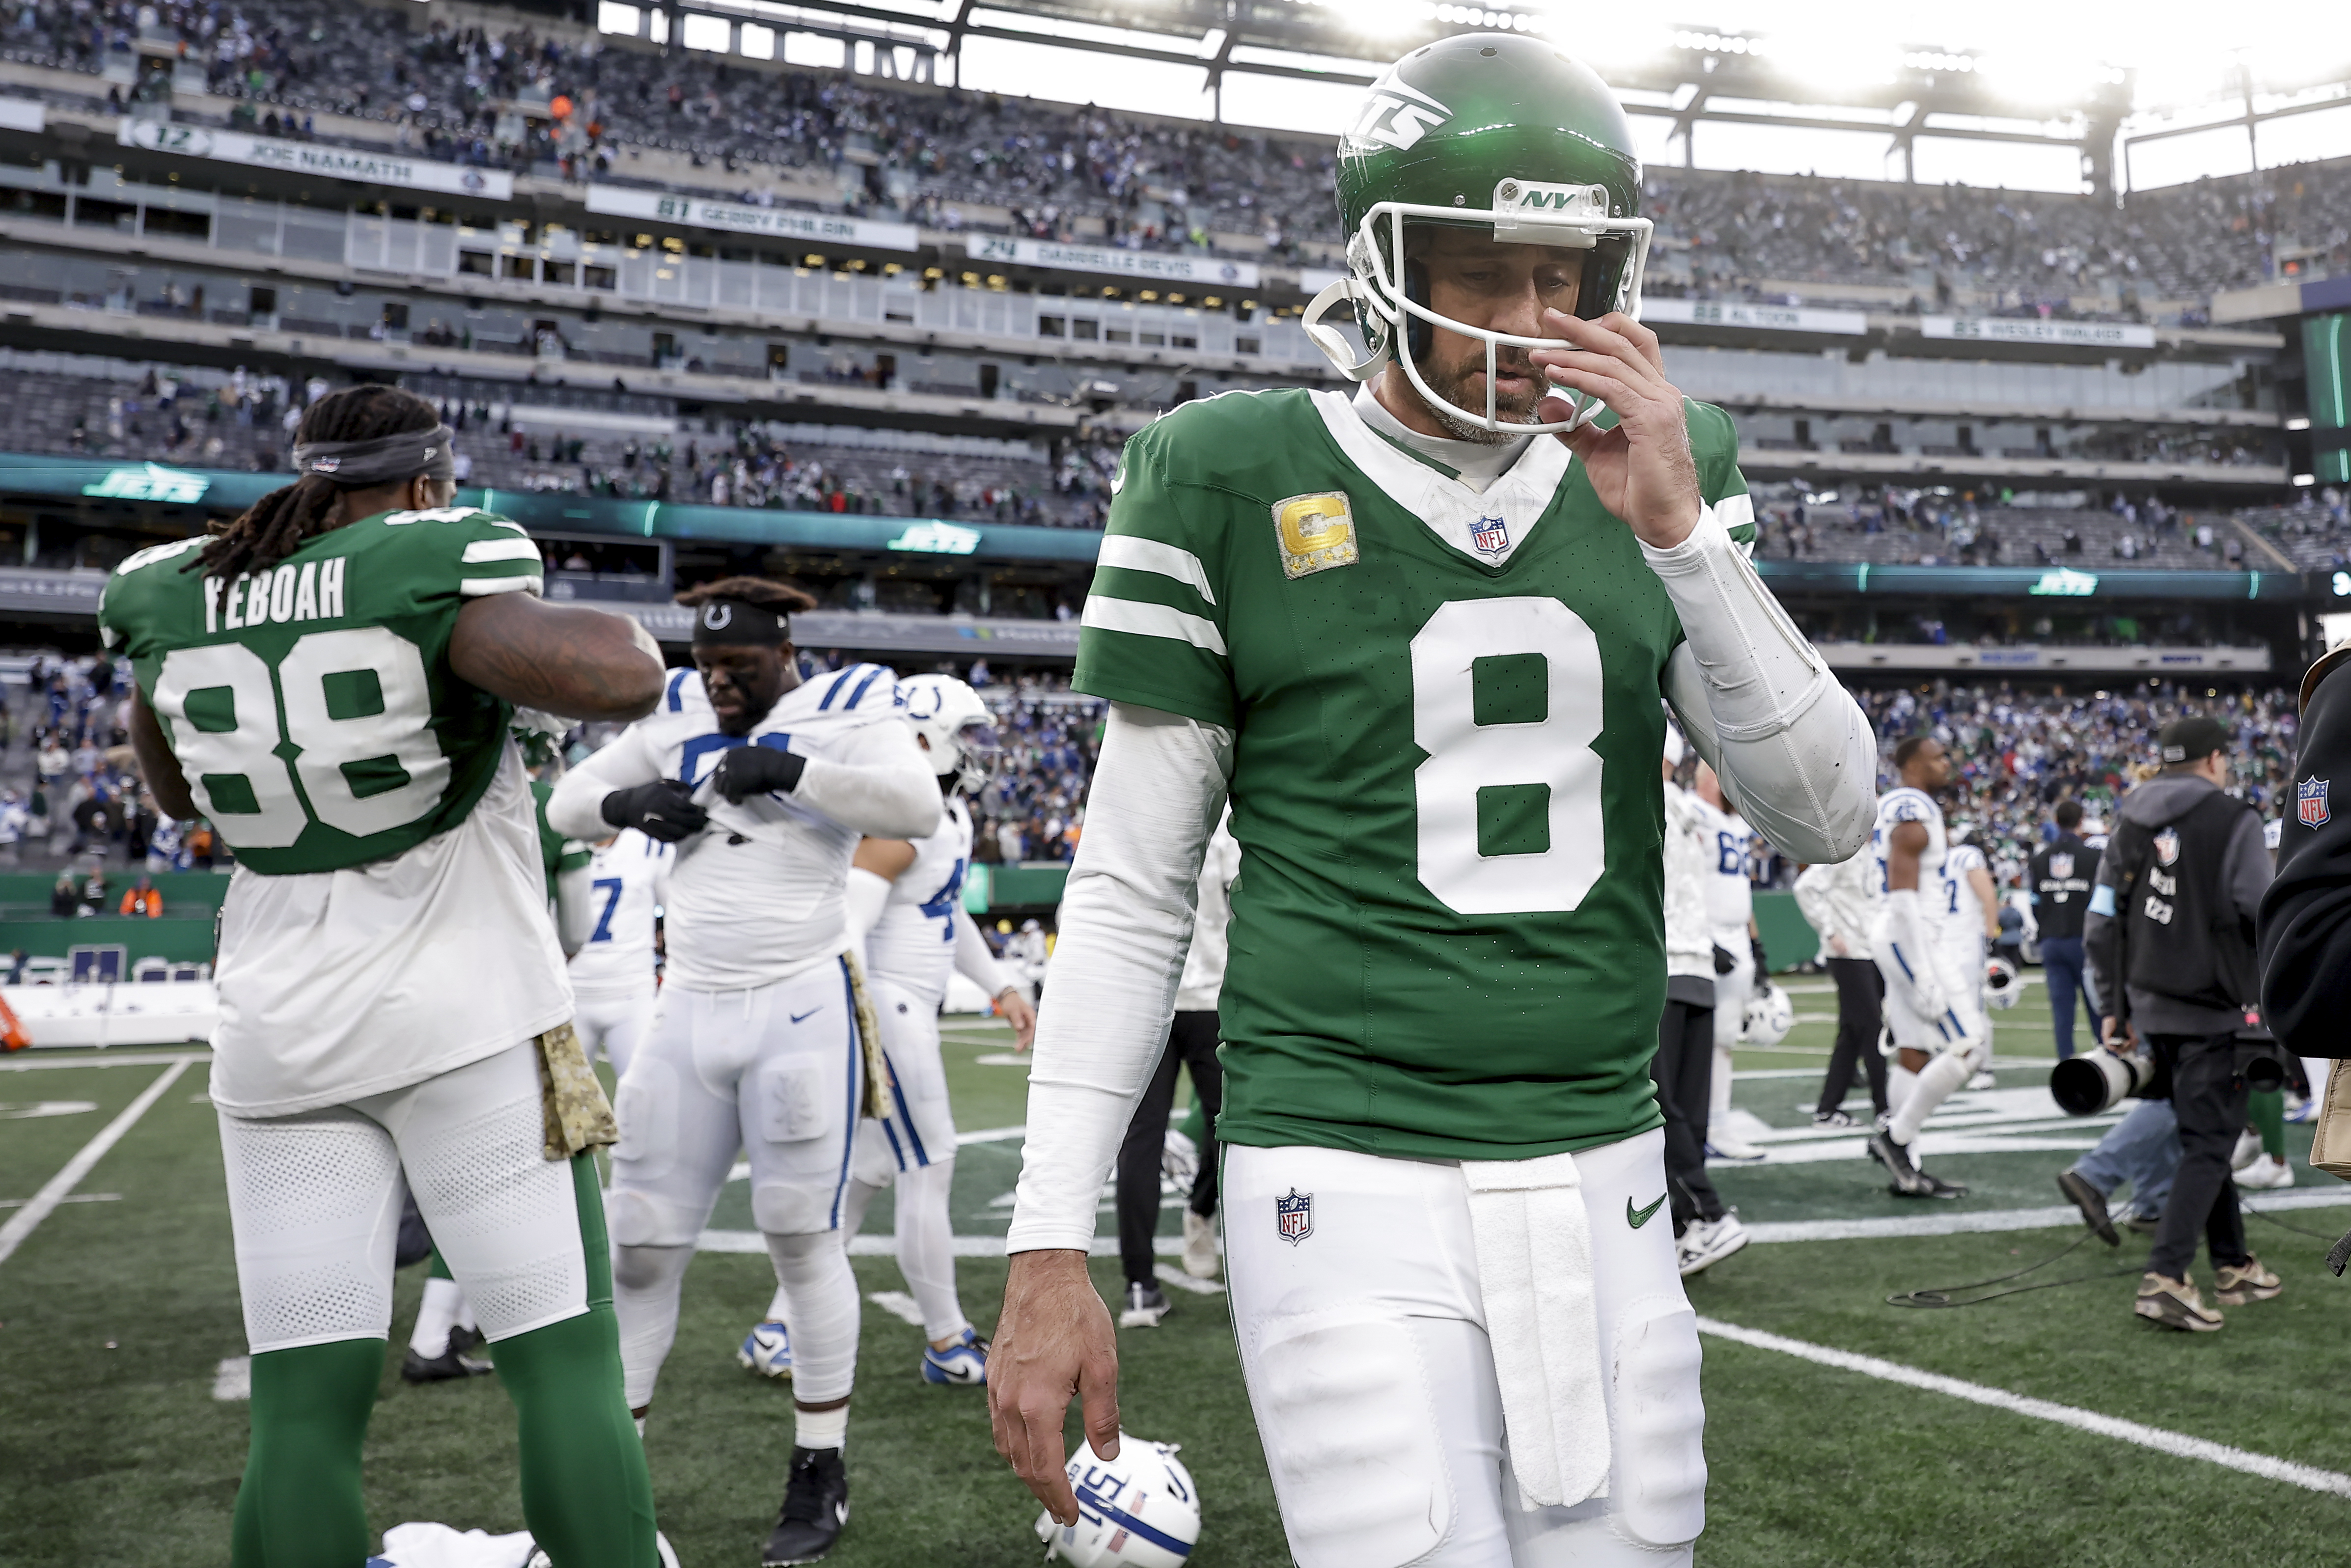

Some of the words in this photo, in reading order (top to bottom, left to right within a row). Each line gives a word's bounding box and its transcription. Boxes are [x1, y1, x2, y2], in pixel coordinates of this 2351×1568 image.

[156, 127, 191, 145] 12
[252, 143, 295, 162] JOE
[300, 150, 413, 180] NAMATH
[1521, 191, 1576, 209] NY
[982, 240, 1016, 257] 24
[82, 461, 211, 504] JETS
[1280, 497, 1348, 555] C
[1476, 530, 1506, 549] NFL
[204, 556, 346, 634] YEBOAH
[152, 626, 451, 849] 88
[1409, 596, 1605, 914] 8
[2301, 798, 2326, 822] NFL
[590, 878, 622, 942] 7
[1282, 1213, 1307, 1235] NFL
